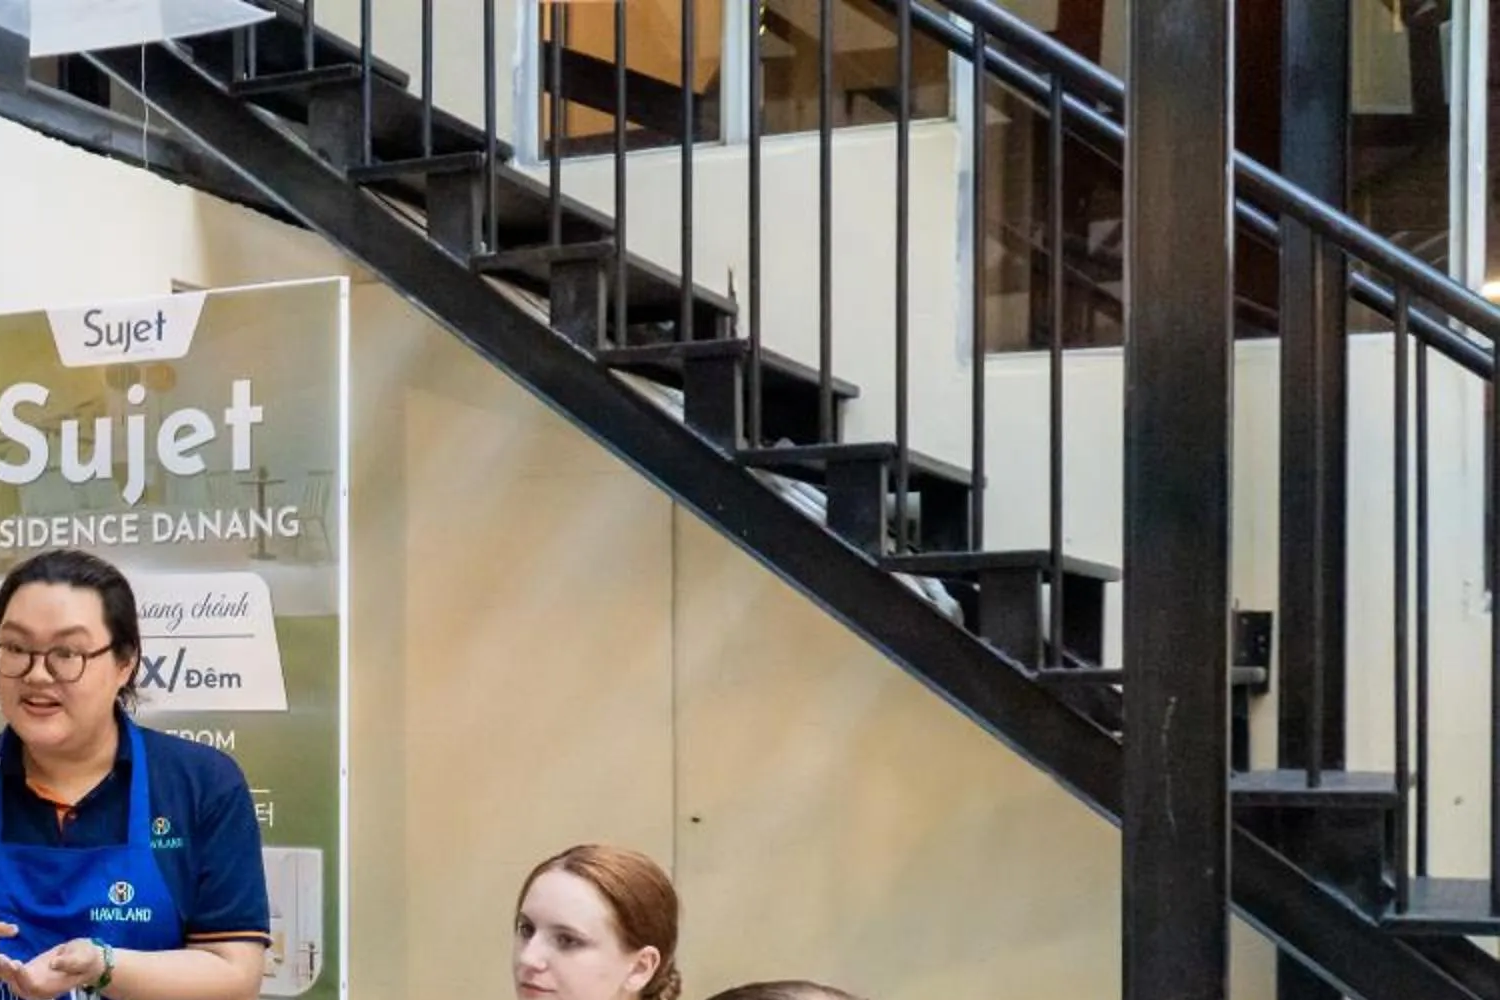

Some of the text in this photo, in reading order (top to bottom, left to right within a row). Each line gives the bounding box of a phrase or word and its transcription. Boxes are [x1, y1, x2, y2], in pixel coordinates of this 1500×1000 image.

[83, 308, 167, 353] Sujet
[152, 505, 301, 543] DANANG
[90, 907, 152, 922] HAVILAND
